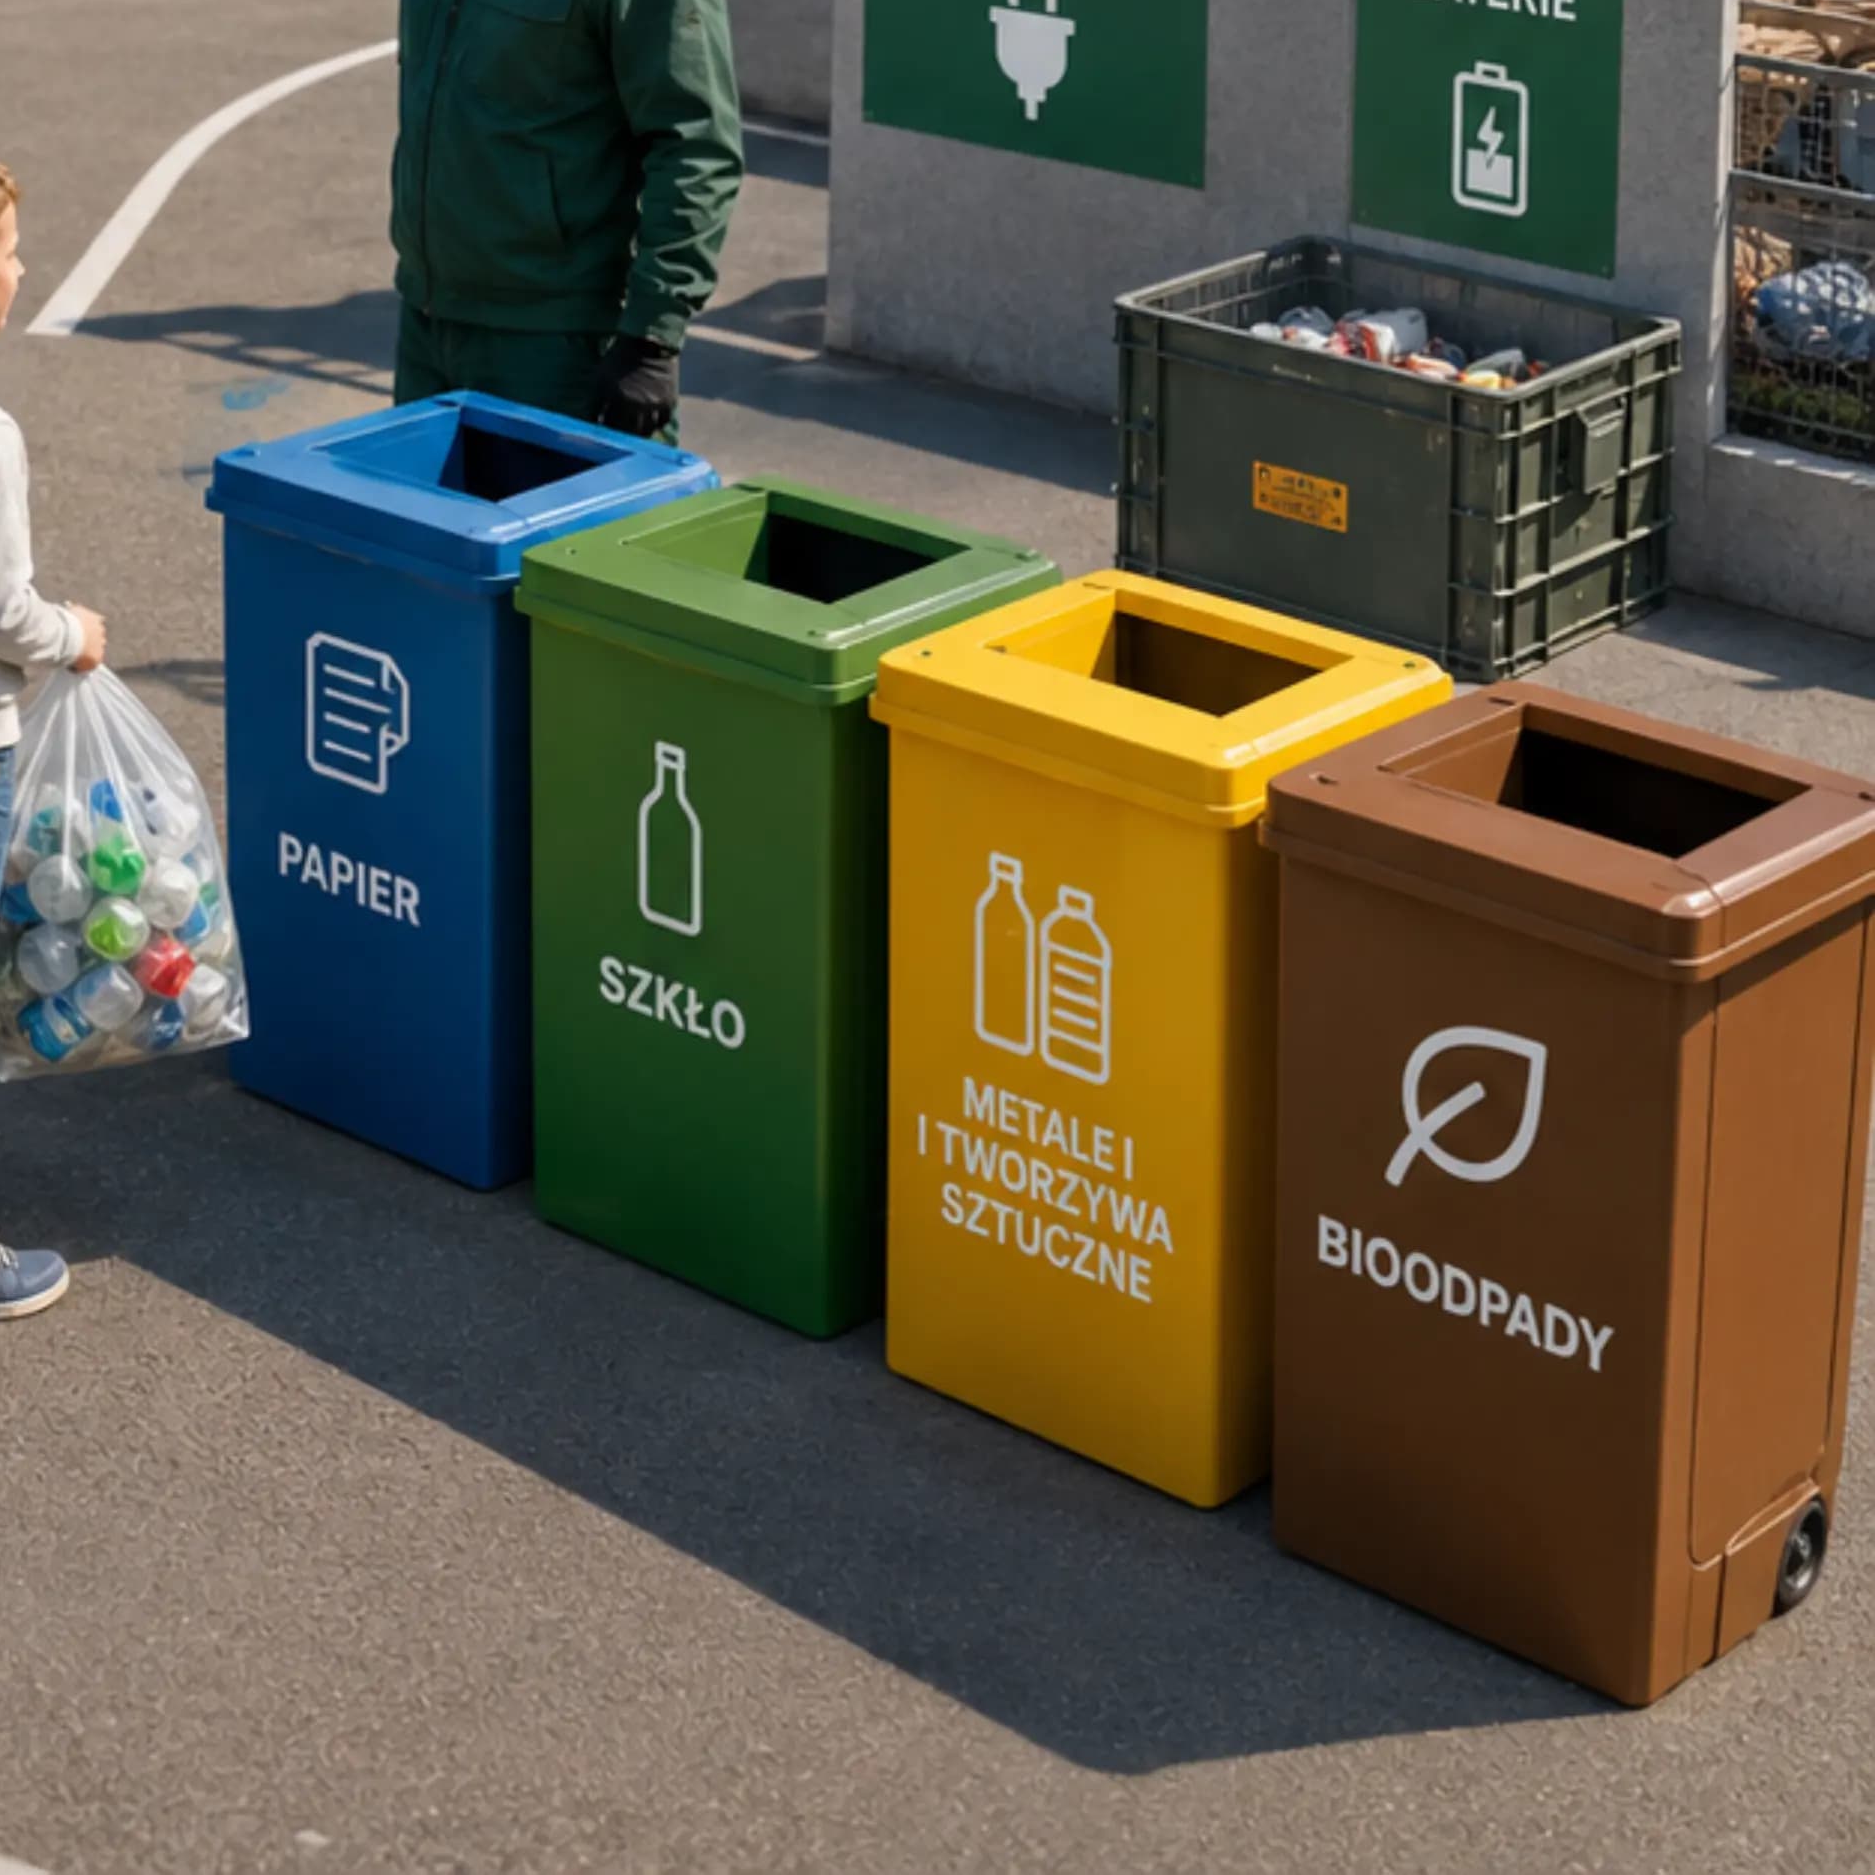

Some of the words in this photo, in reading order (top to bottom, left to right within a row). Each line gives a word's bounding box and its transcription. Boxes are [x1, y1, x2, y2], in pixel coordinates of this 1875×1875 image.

[278, 831, 421, 927] PAPIER
[598, 955, 747, 1049] SZKŁO
[918, 1113, 927, 1156] I
[935, 1120, 1174, 1254] TWORZYWA
[963, 1076, 1115, 1173] METALE
[1124, 1136, 1133, 1181] I
[940, 1181, 1152, 1304] SZTUCZNE
[1317, 1213, 1615, 1373] BIOODPADY
